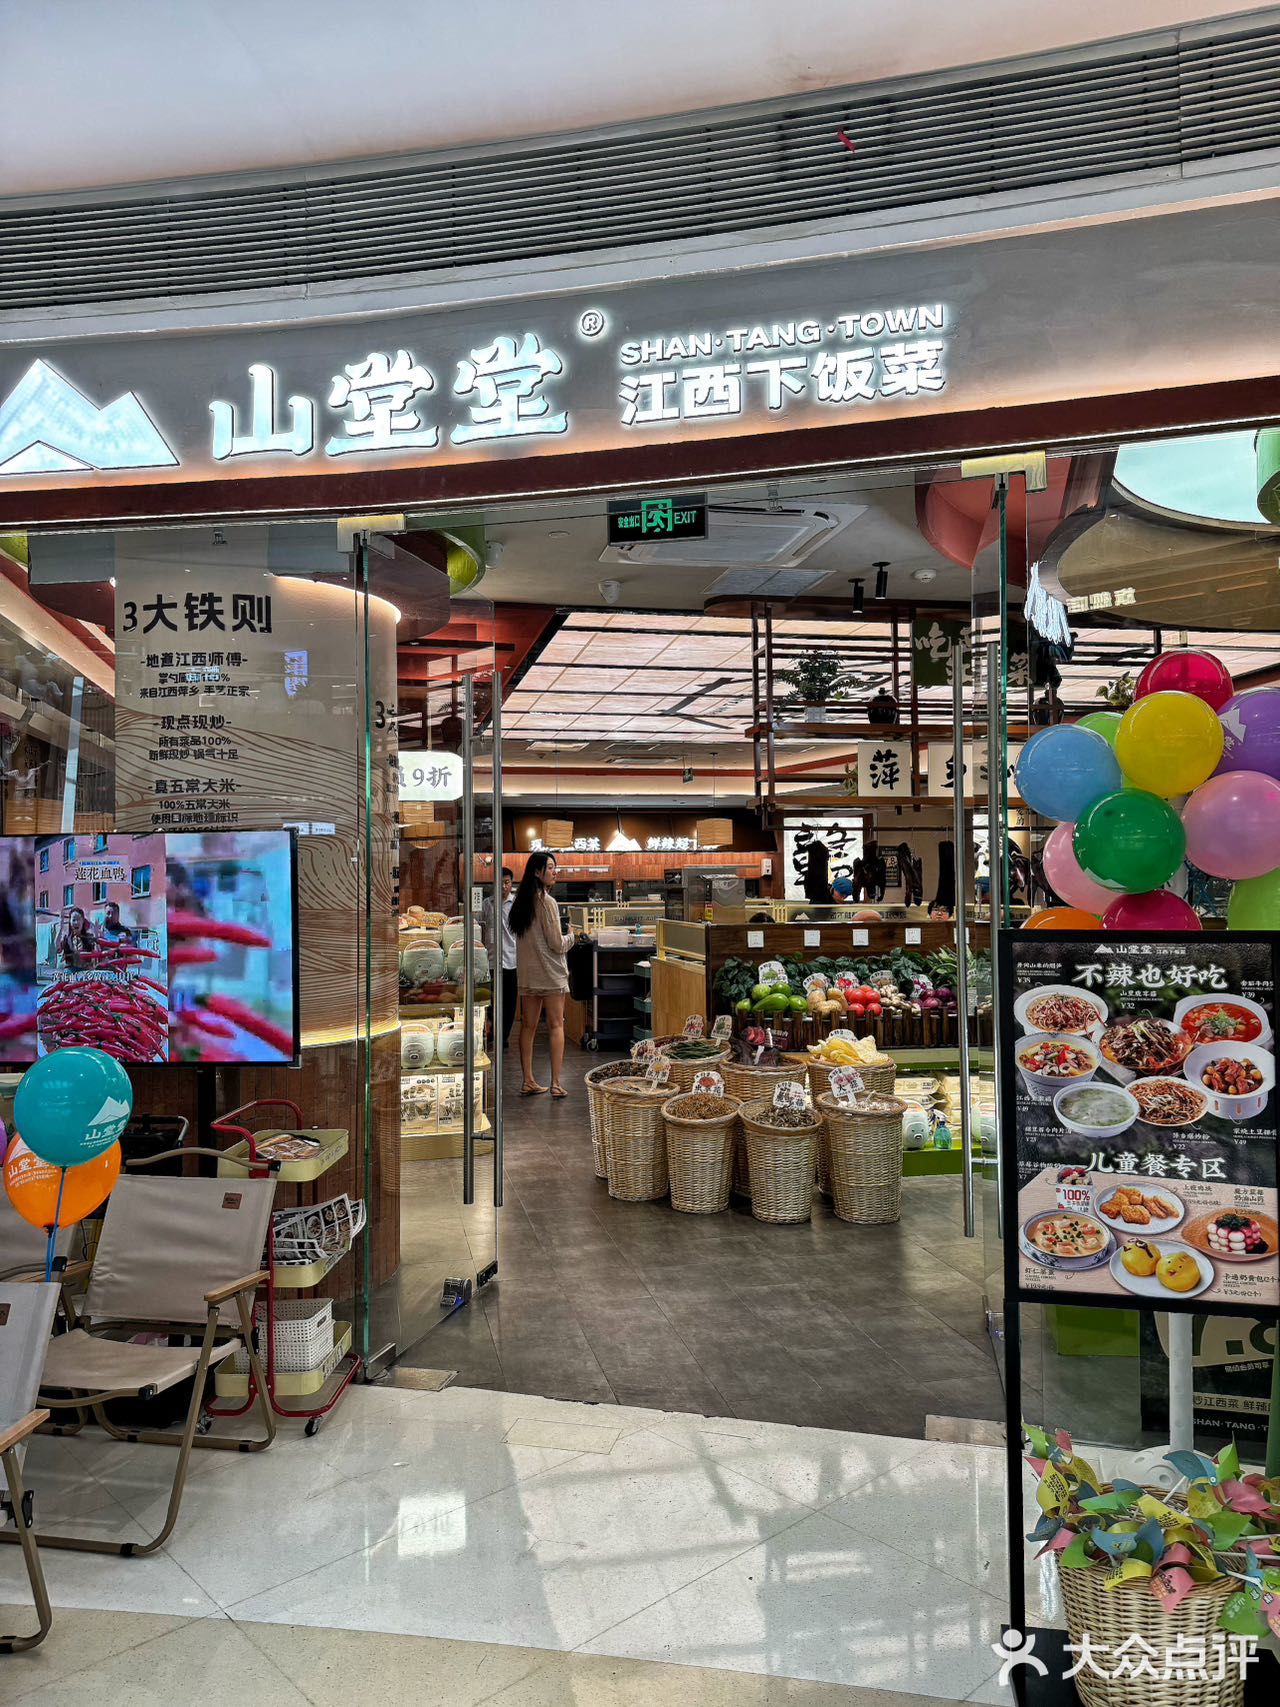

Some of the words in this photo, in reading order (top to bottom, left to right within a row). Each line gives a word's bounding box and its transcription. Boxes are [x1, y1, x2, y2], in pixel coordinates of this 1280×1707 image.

[618, 339, 946, 426] 江西下饭菜
[210, 331, 568, 458] 山堂堂
[617, 514, 641, 529] 安全出口
[674, 510, 698, 525] EXIT
[122, 591, 273, 635] 3大铁则
[140, 686, 200, 699] 来自江西萍乡
[159, 735, 232, 747] 所有菜品100%
[159, 799, 231, 811] 100%五常大米
[1071, 961, 1229, 989] 不辣也好吃
[1086, 1151, 1228, 1179] 儿童餐专区
[1062, 1189, 1091, 1201] 100%
